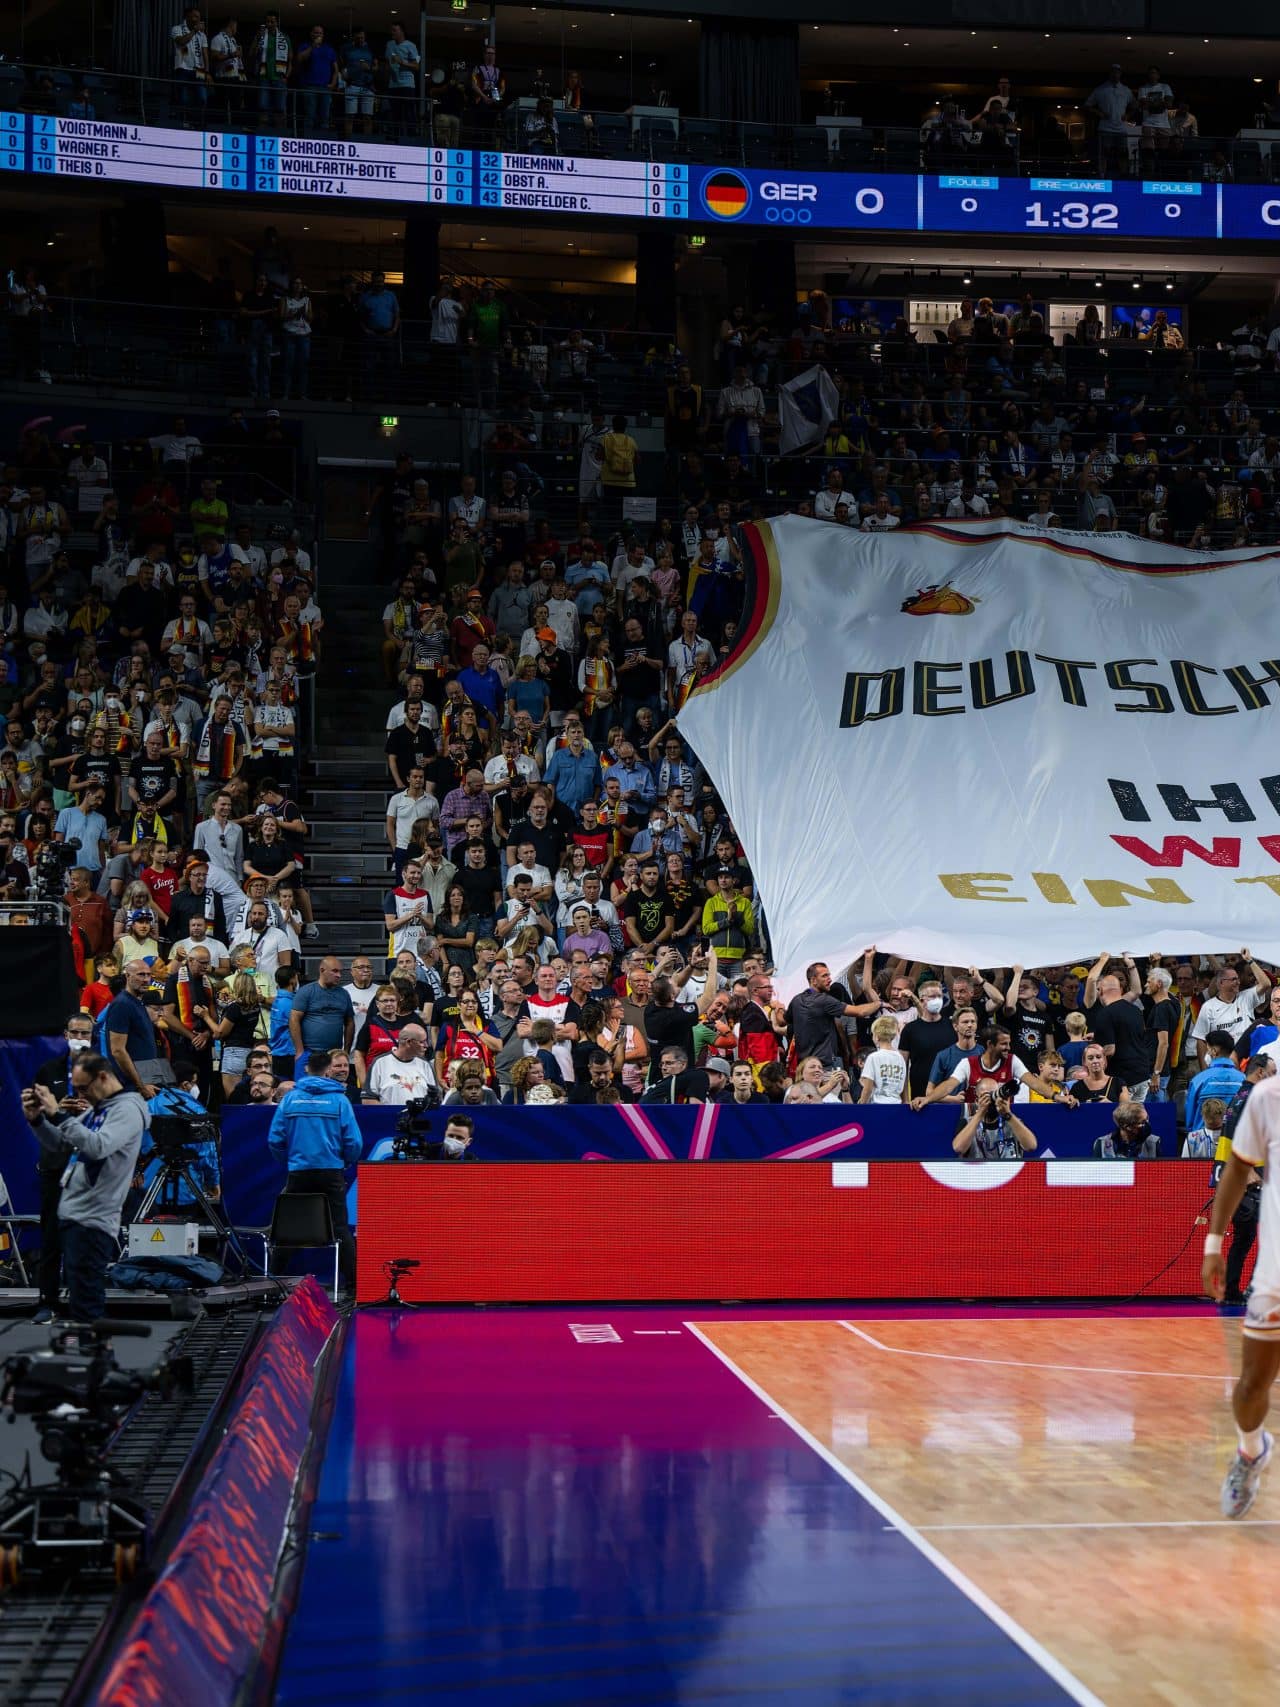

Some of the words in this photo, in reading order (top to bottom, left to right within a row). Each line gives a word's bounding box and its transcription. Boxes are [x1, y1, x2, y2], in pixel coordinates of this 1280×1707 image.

[9, 115, 16, 128] 0
[9, 135, 16, 147] 0
[41, 119, 48, 131] 7
[59, 120, 127, 139] VOIGTMANN
[131, 127, 141, 141] J.
[210, 135, 218, 148] 0
[232, 137, 239, 150] 0
[9, 154, 16, 167] 0
[41, 138, 48, 151] 9
[59, 140, 108, 156] WAGNER
[112, 145, 120, 158] F.
[210, 154, 218, 167] 0
[232, 156, 239, 168] 0
[259, 139, 275, 152] 17
[281, 140, 345, 157] SCHRODER
[348, 145, 360, 158] D.
[435, 151, 442, 163] 0
[456, 152, 464, 165] 0
[37, 157, 51, 170] 10
[59, 159, 92, 174] THEIS
[96, 162, 106, 176] D.
[210, 173, 218, 185] 0
[232, 175, 239, 187] 0
[259, 158, 275, 170] 18
[281, 159, 397, 179] WOHLFARTH-BOTTE
[435, 169, 442, 182] 0
[456, 171, 464, 183] 0
[483, 154, 498, 167] 32
[505, 156, 564, 172] THIEMANN
[567, 160, 578, 173] J.
[653, 165, 660, 178] 0
[673, 166, 680, 179] 0
[258, 177, 274, 189] 21
[281, 178, 333, 193] HOLLATZ
[336, 182, 347, 194] J.
[435, 188, 442, 200] 0
[456, 189, 464, 202] 0
[483, 172, 498, 185] 42
[505, 174, 535, 189] OBST
[538, 176, 549, 189] A.
[653, 184, 660, 196] 0
[673, 185, 680, 197] 0
[760, 182, 818, 201] GER
[948, 177, 991, 187] FOULS
[1037, 181, 1106, 191] PRE-GAME
[1151, 183, 1194, 193] FOULS
[483, 191, 498, 204] 43
[504, 193, 577, 209] SENGFELDER
[580, 197, 591, 211] C.
[653, 202, 660, 214] 0
[673, 203, 680, 215] 0
[855, 188, 884, 214] 0
[961, 198, 978, 213] 0
[1164, 203, 1181, 218] 0
[1025, 202, 1119, 229] 1:32
[938, 872, 1194, 907] EIN
[461, 1046, 480, 1058] 32
